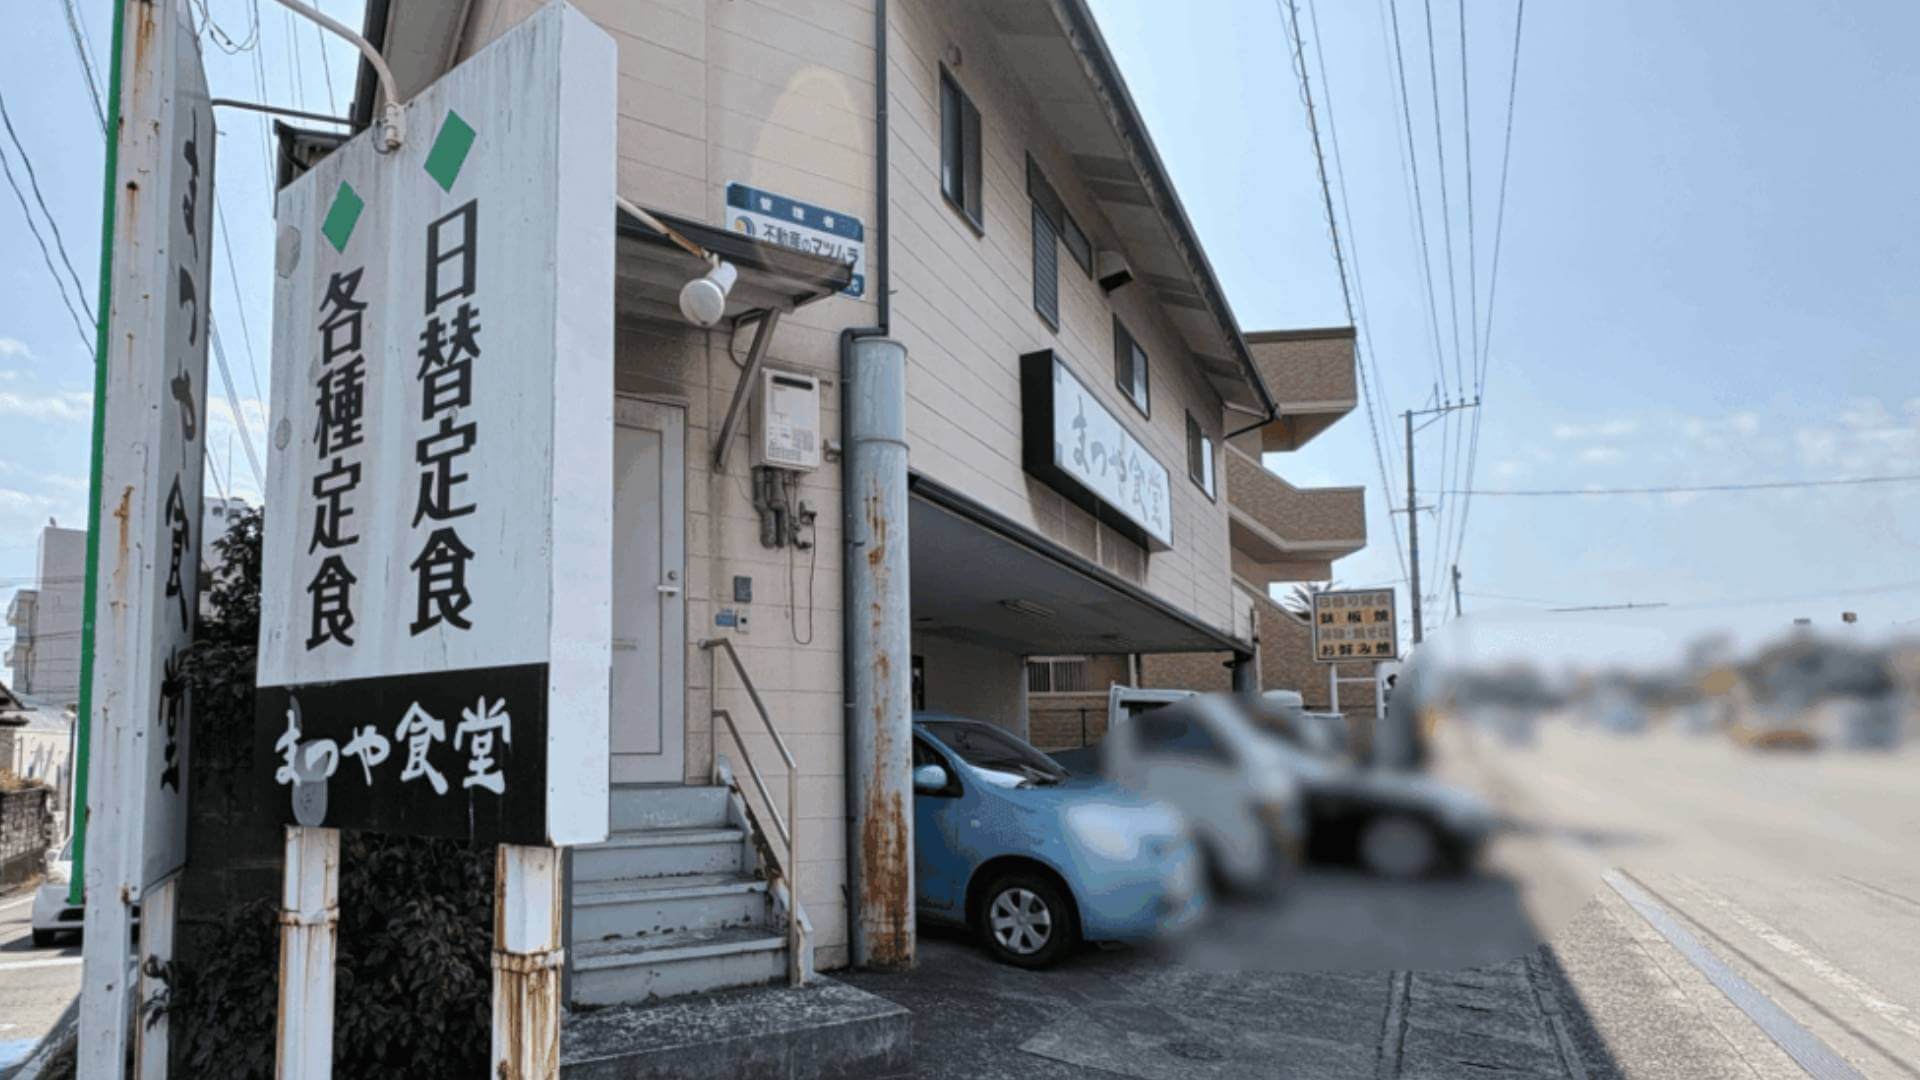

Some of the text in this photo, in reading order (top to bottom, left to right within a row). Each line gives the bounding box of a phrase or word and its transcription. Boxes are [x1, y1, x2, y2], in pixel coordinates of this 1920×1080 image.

[306, 266, 367, 651] 各種定食
[410, 198, 481, 636] 日替定食
[1072, 393, 1163, 532] まつや食堂
[1322, 641, 1390, 656] お好み焼
[275, 695, 512, 795] まつや食堂
